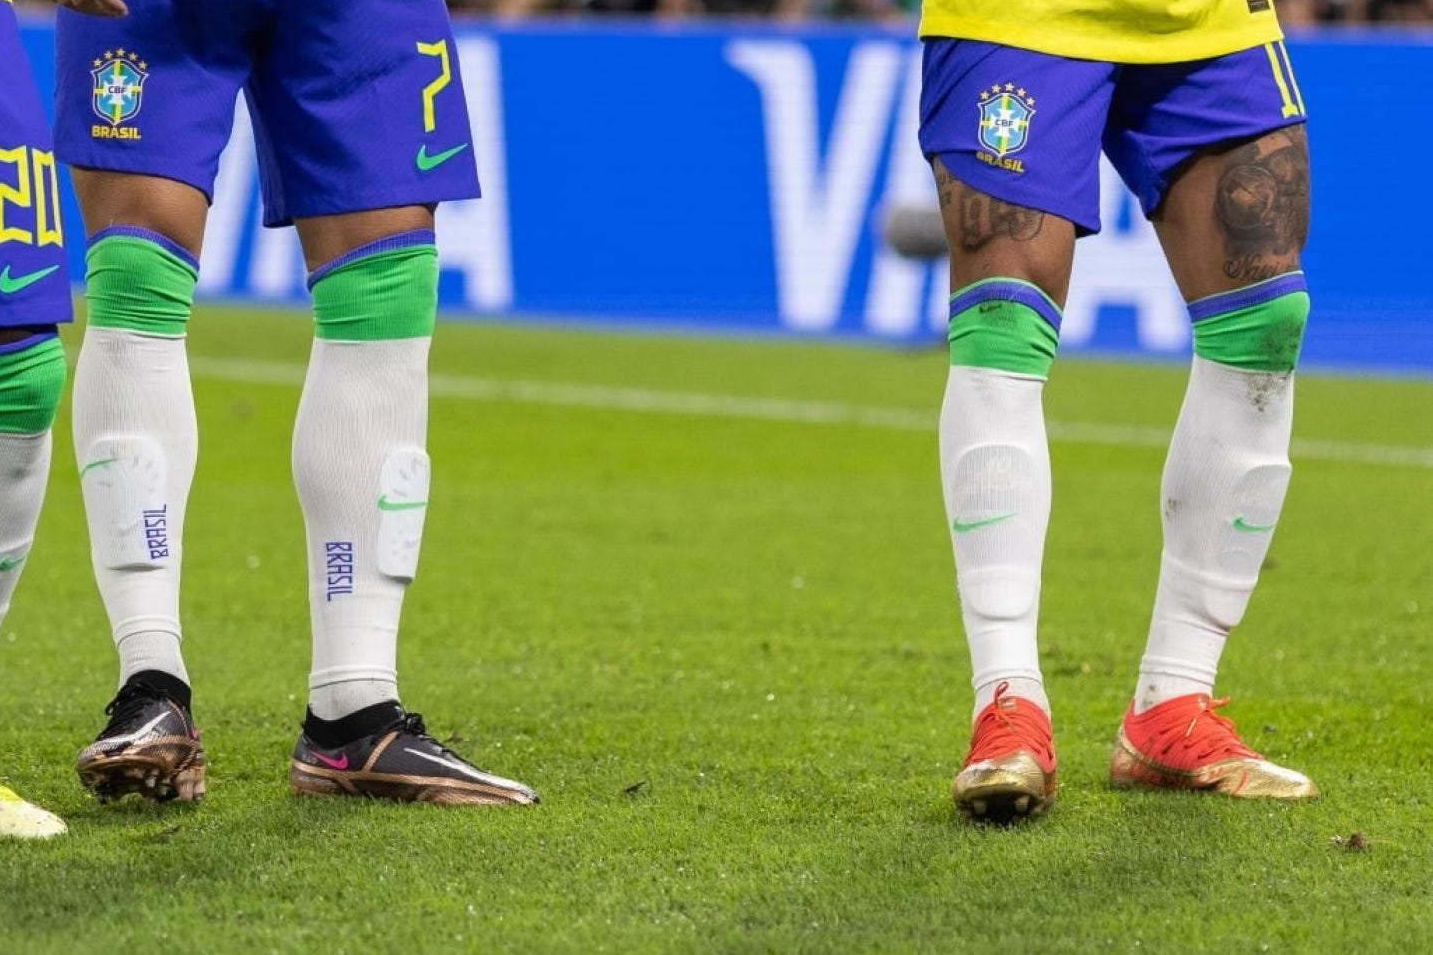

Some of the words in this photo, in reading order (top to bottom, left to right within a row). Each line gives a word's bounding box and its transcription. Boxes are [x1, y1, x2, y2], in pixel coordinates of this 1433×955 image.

[108, 85, 127, 94] CBF
[416, 38, 451, 133] 7
[91, 125, 142, 139] BRASIL
[976, 151, 1025, 174] BRASIL
[142, 503, 169, 561] BRASIL
[325, 542, 353, 602] BRASIL
